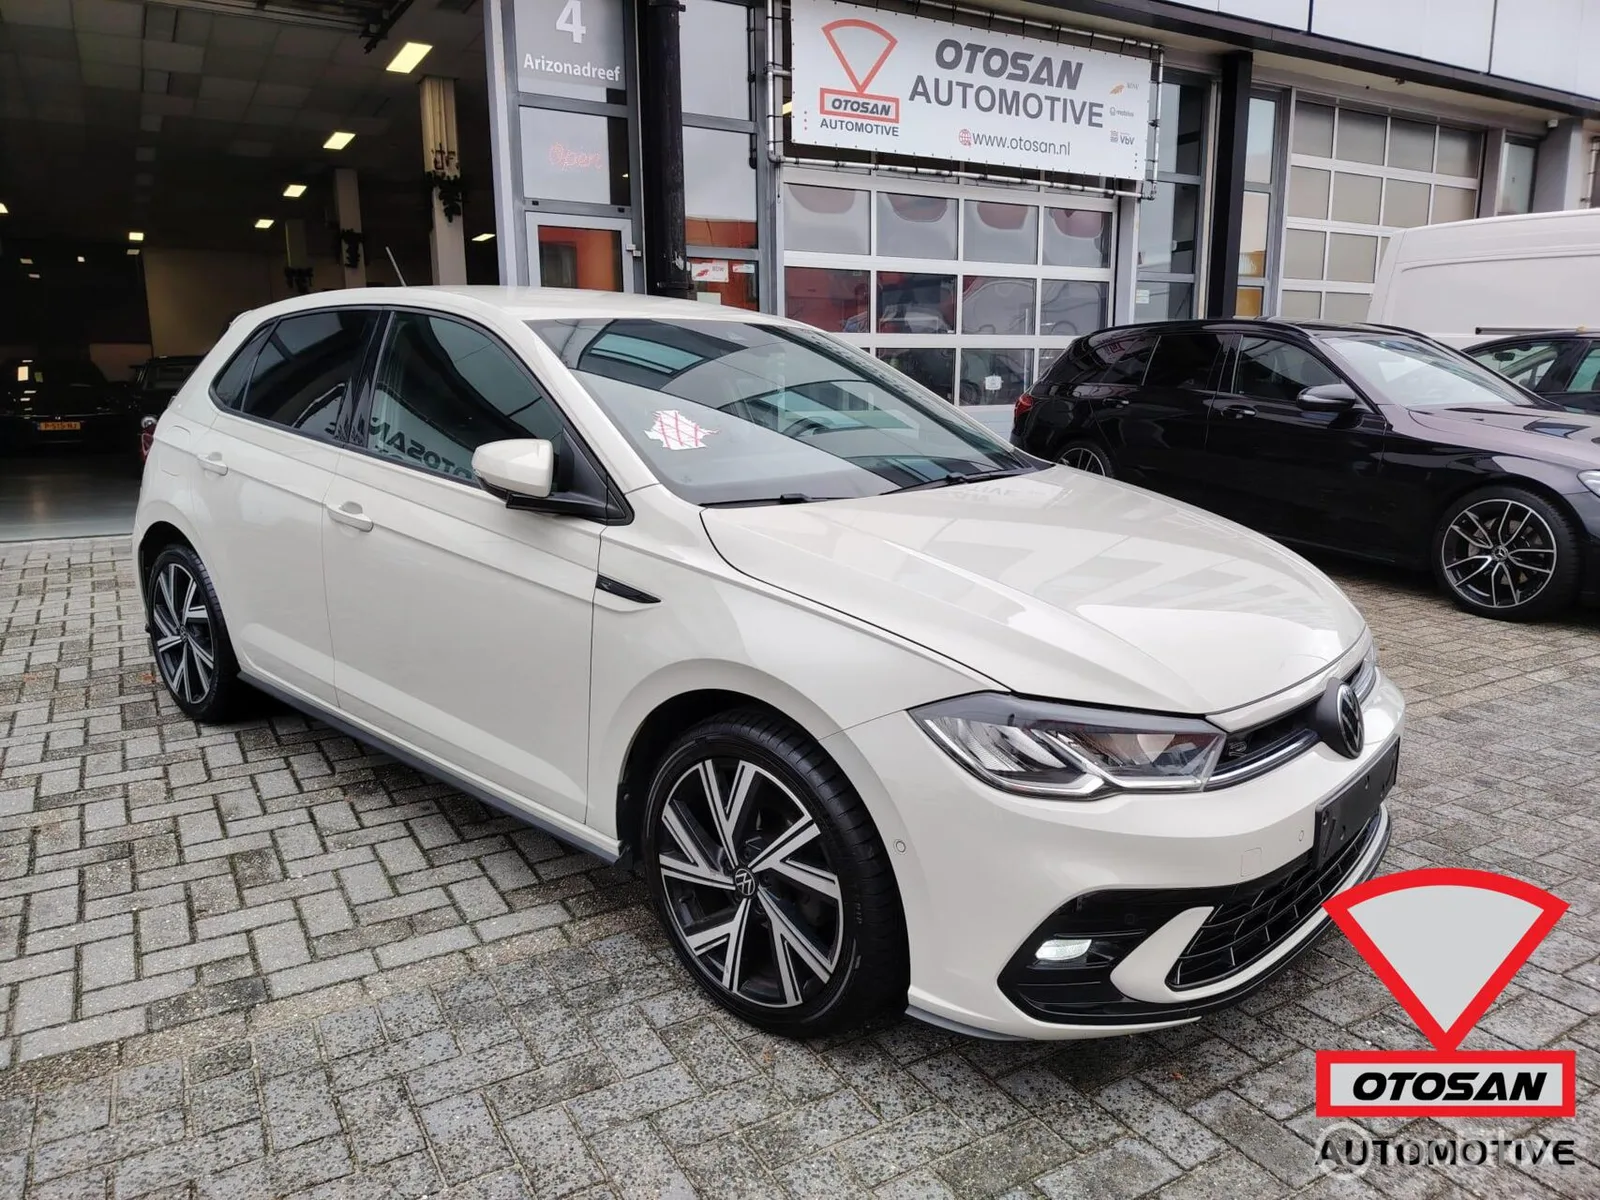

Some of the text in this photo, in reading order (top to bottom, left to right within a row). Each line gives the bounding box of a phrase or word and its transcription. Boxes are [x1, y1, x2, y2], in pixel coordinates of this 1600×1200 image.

[555, 0, 586, 44] 4
[524, 53, 621, 82] Arizonadreef
[935, 38, 1083, 90] OTOSAN
[831, 98, 892, 116] OTOSAN
[909, 75, 1104, 128] AUTOMOTIVE
[820, 118, 899, 137] AUTOMOTIVE
[973, 131, 1071, 156] www.otosan.nl
